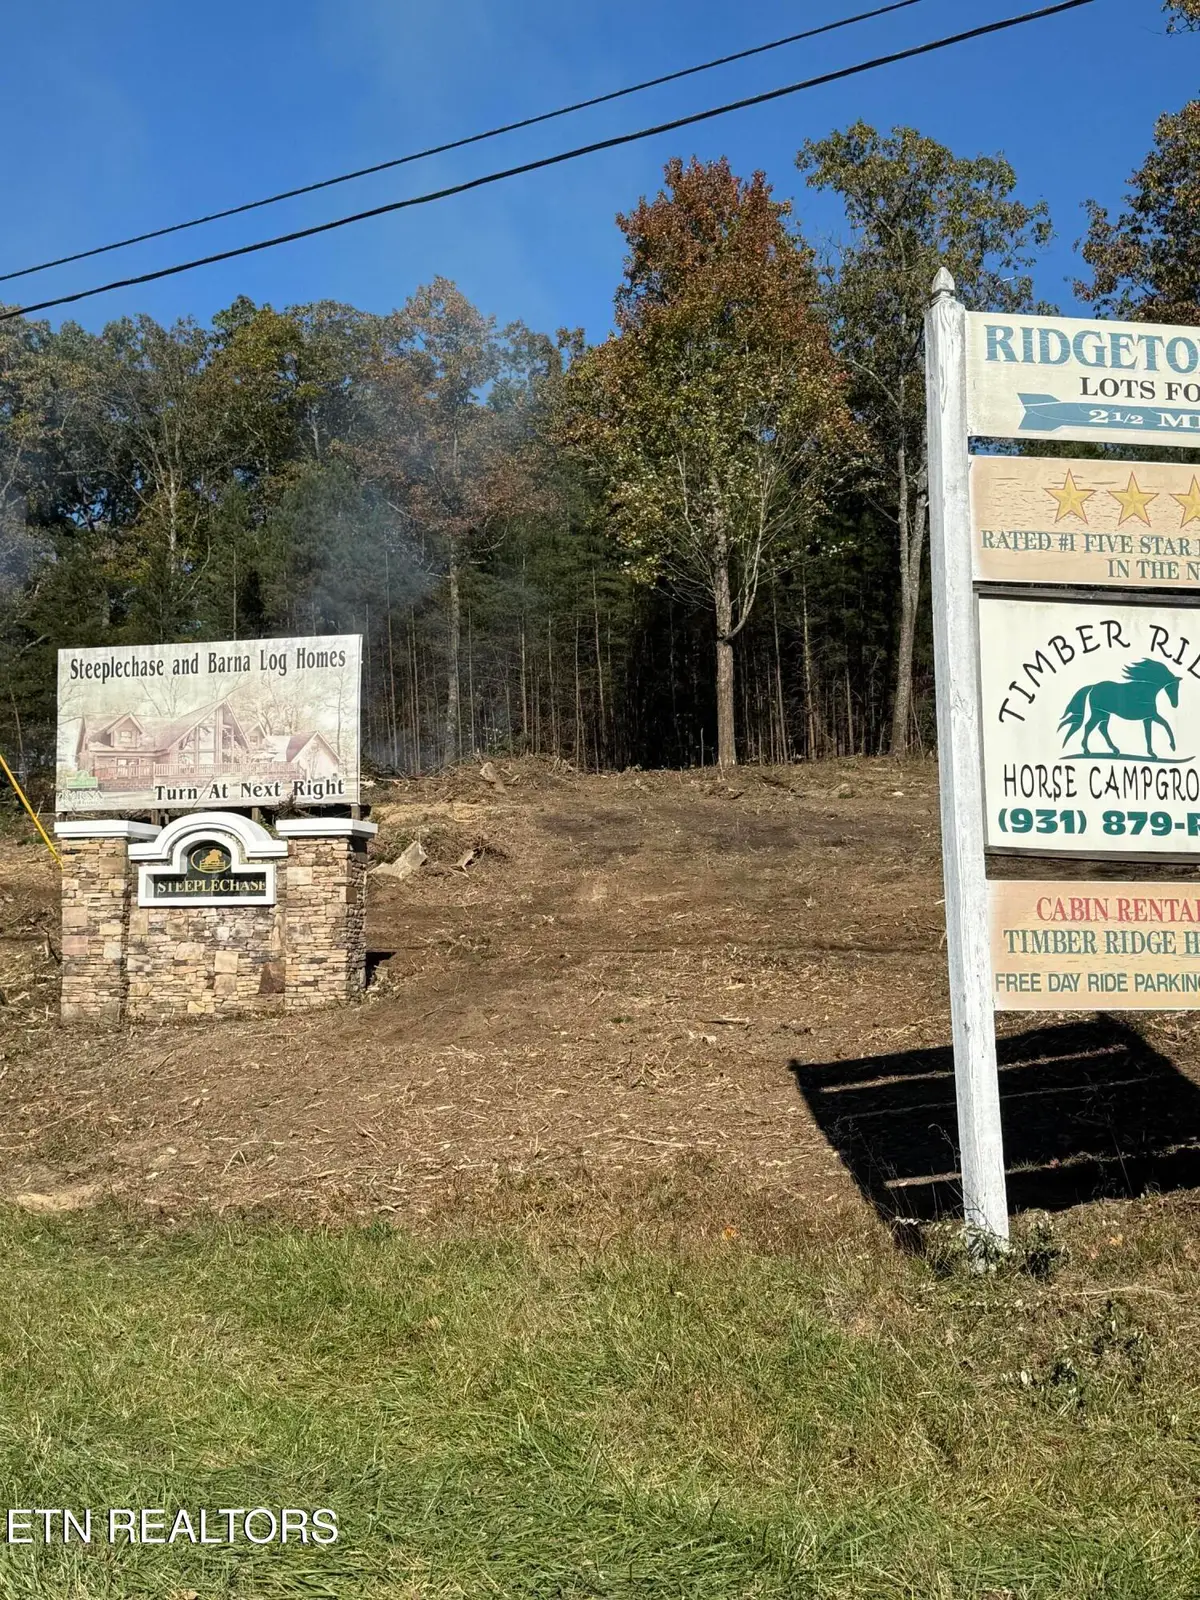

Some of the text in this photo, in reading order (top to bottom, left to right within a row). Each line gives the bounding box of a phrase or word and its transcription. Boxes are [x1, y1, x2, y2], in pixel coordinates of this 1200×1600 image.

[984, 324, 1200, 374] RIDGETO
[1079, 377, 1155, 400] LOTS
[981, 530, 1051, 551] RATED
[1058, 534, 1076, 553] #1
[1084, 533, 1134, 554] FIVE
[1139, 536, 1191, 557] STAR
[1108, 559, 1130, 578] IN
[1136, 560, 1180, 580] THE
[70, 647, 346, 684] Steeplechase and Barna Log Homes
[999, 620, 1131, 722] TIMBER
[155, 778, 345, 801] Turn At Next Right
[1003, 763, 1200, 802] HORSE CAMPGRO
[998, 808, 1087, 835] (931)
[157, 879, 267, 894] STEEPLECHASE
[1036, 896, 1110, 922] CABIN
[1003, 929, 1097, 955] TIMBER
[1104, 930, 1177, 955] RIDGE
[995, 972, 1200, 993] FREE DAY RIDE PARKIN
